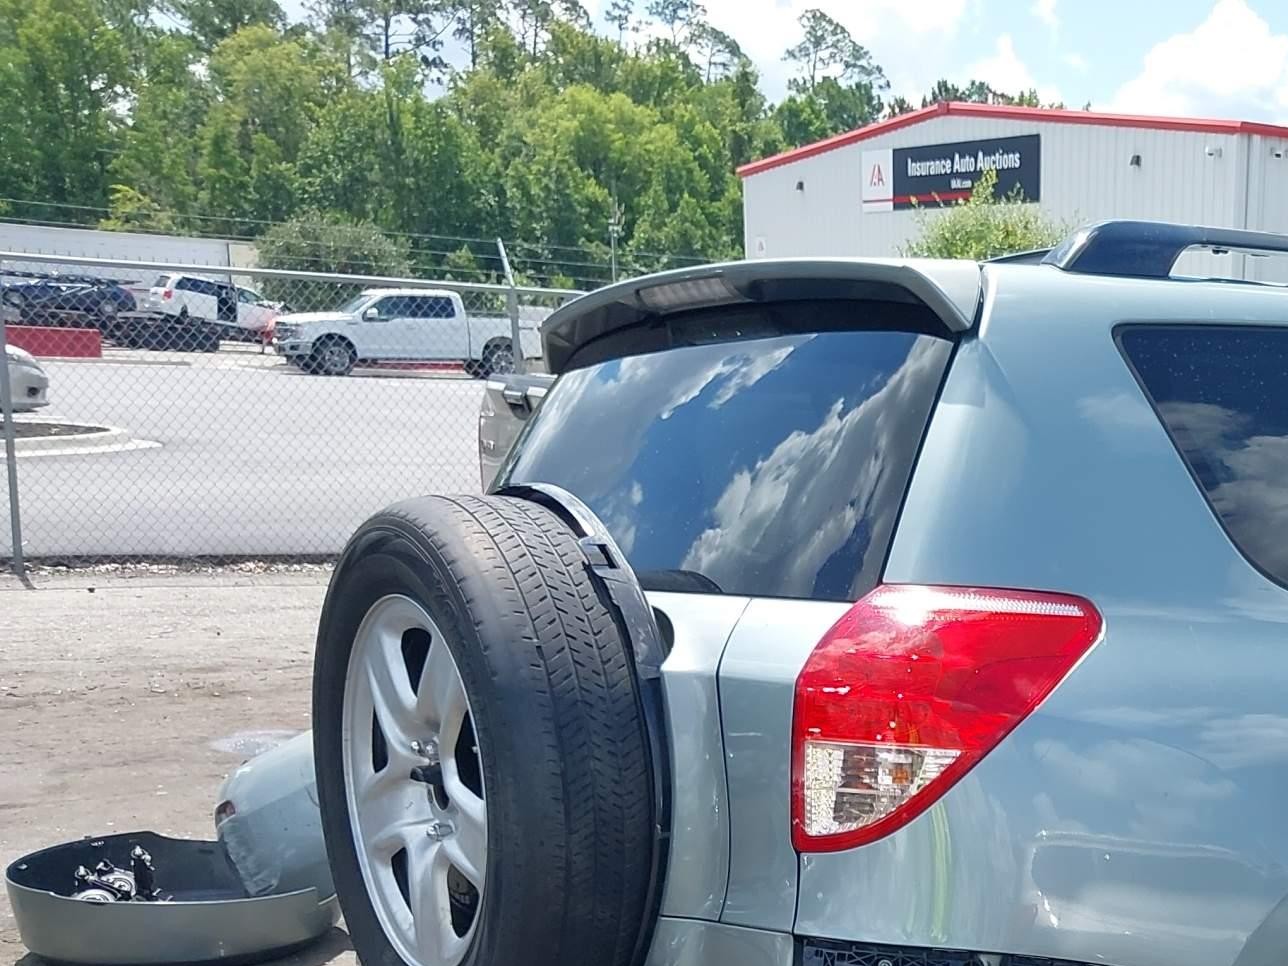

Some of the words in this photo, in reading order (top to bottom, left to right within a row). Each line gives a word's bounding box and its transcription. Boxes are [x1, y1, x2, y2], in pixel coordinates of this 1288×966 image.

[907, 156, 952, 177] Insurance
[953, 153, 975, 173] Auto
[976, 149, 1021, 172] Auctions
